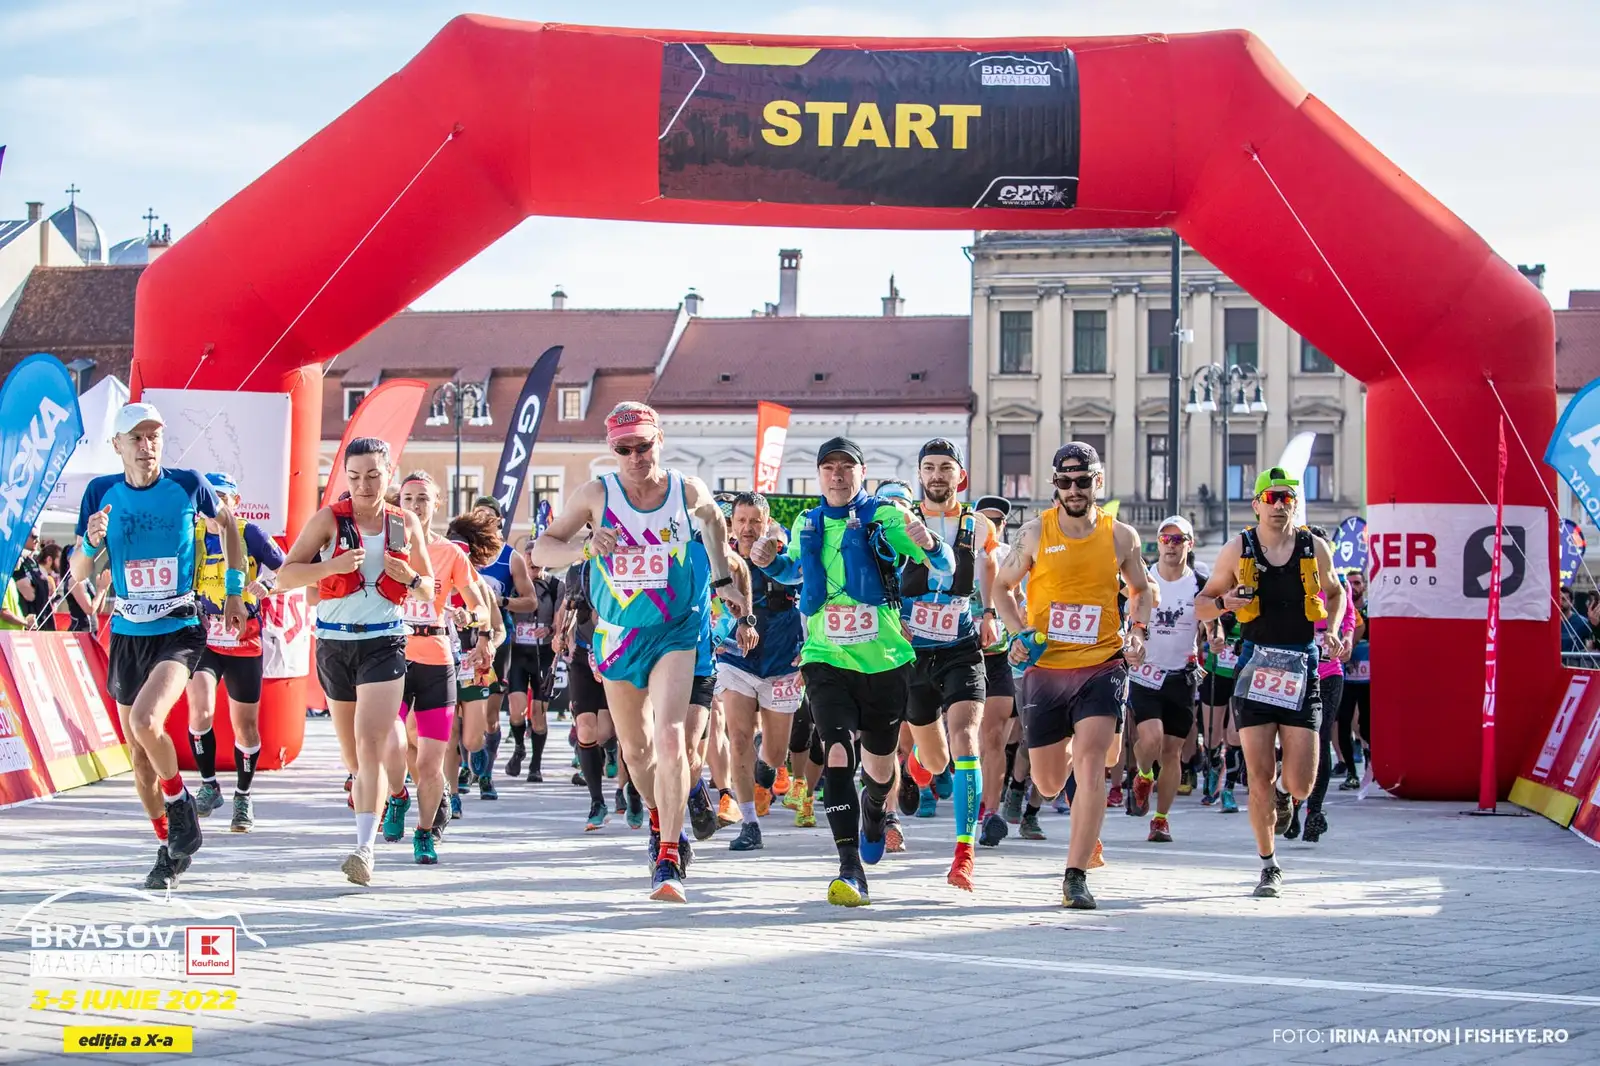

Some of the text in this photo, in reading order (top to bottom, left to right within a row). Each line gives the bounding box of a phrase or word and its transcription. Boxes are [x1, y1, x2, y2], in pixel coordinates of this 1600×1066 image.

[982, 65, 1049, 75] BRASOV
[983, 75, 1050, 85] MARATHON
[761, 99, 981, 150] START
[497, 394, 540, 516] GAR
[1045, 544, 1067, 555] HOKA
[615, 555, 664, 576] 826
[130, 567, 172, 588] 819
[1382, 575, 1437, 586] FOOD
[828, 612, 873, 631] 923
[915, 608, 954, 630] 816
[1052, 611, 1097, 632] 867
[1253, 673, 1297, 697] 825
[826, 804, 851, 814] omon
